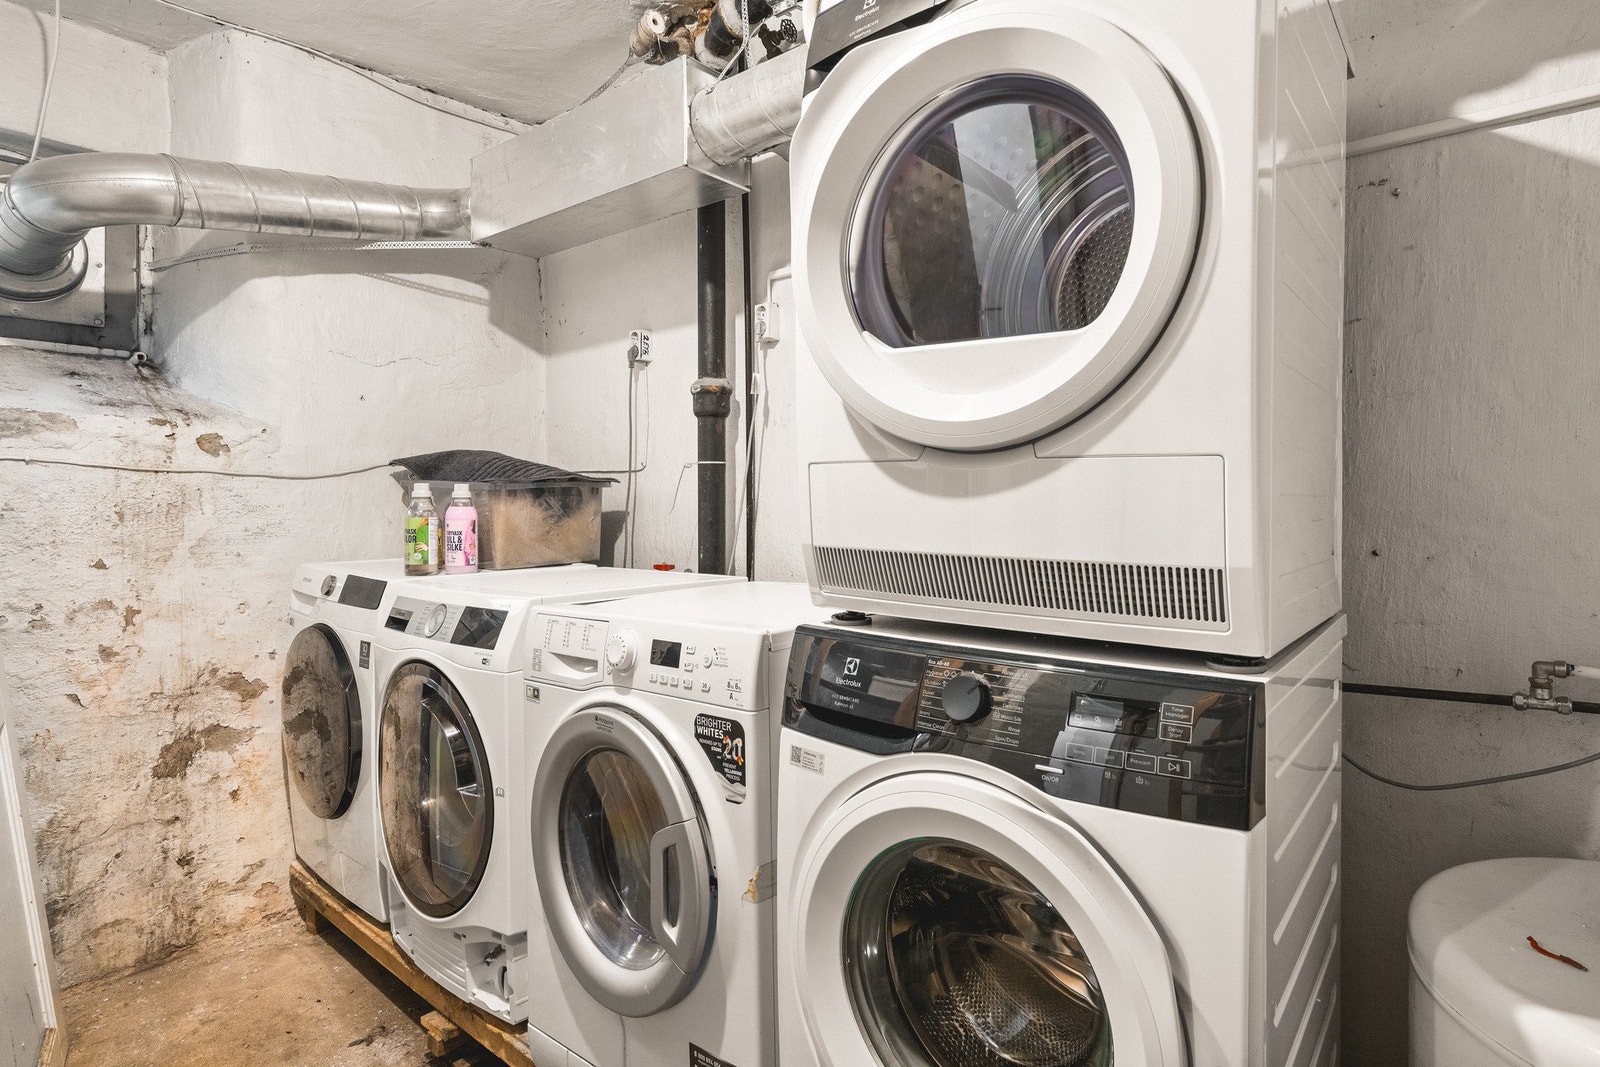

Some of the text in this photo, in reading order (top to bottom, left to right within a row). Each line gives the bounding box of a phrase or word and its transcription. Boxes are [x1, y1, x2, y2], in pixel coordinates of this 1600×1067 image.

[835, 676, 862, 688] Electrolux
[1165, 712, 1190, 720] Manager
[696, 716, 732, 732] BRIGHTER
[696, 726, 724, 738] WHITES
[1167, 726, 1184, 734] Delay
[722, 736, 744, 766] 20
[1129, 756, 1152, 766] Prewash
[1041, 774, 1060, 782] On/Off
